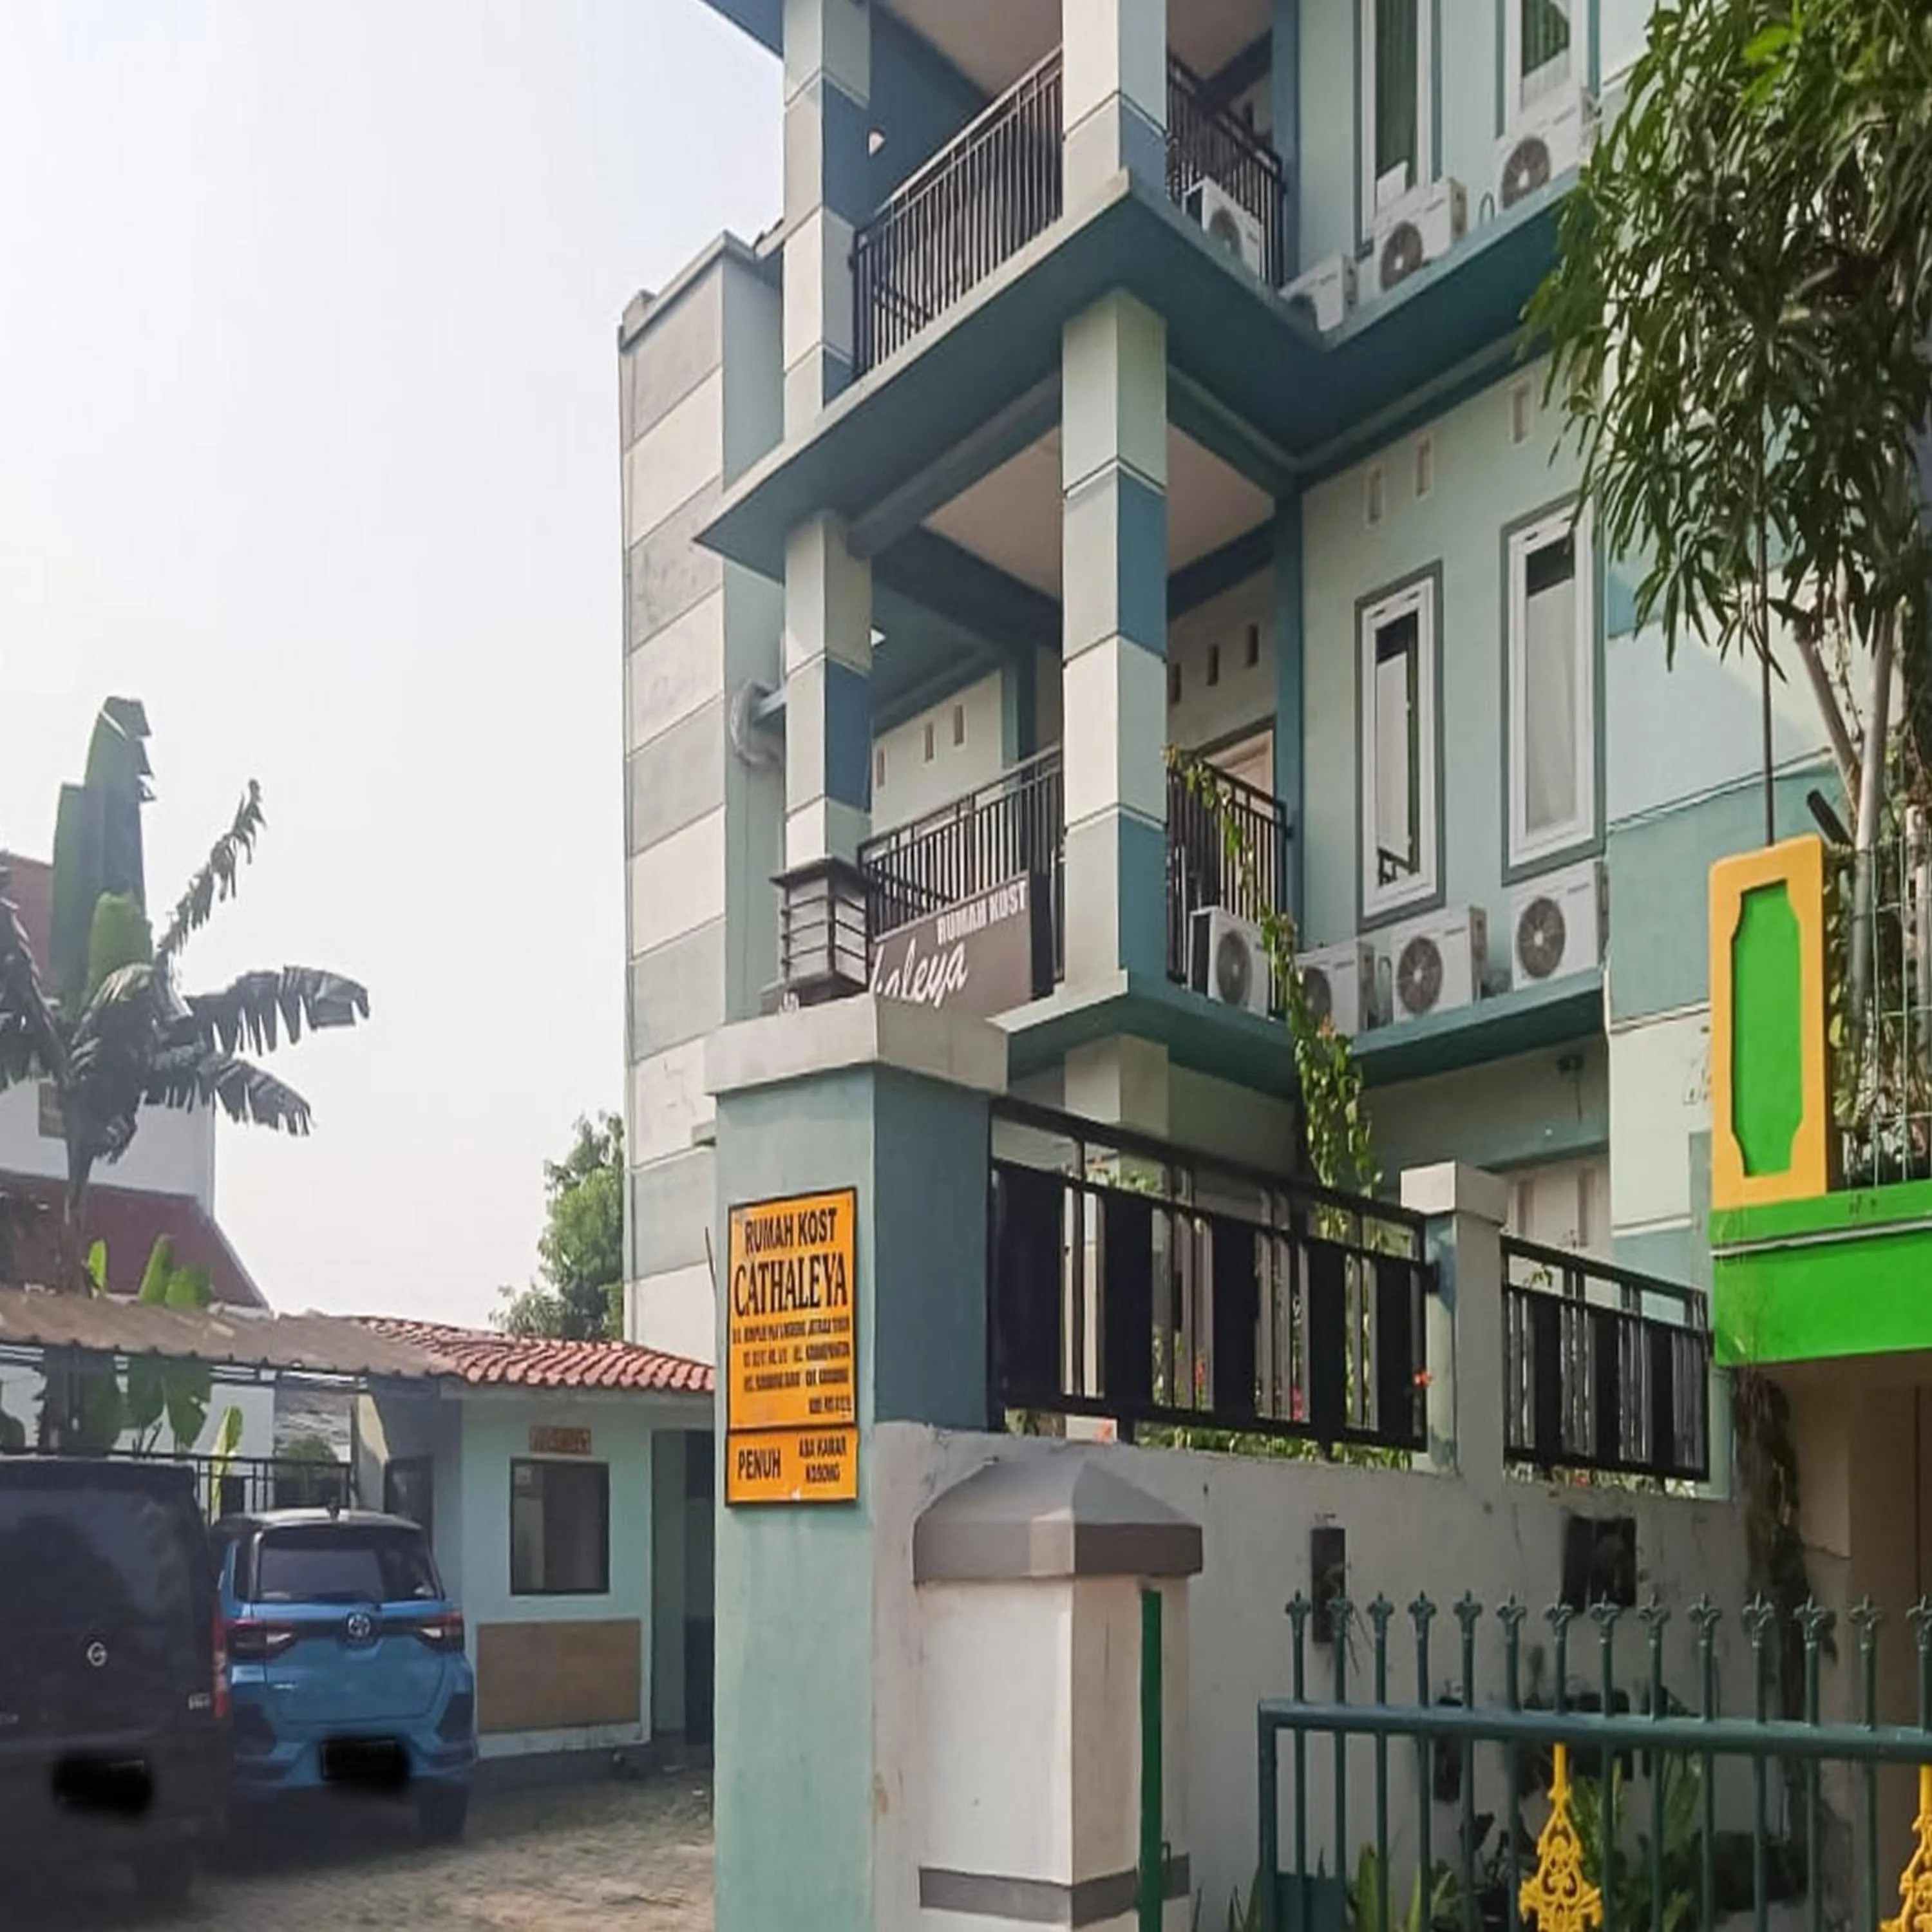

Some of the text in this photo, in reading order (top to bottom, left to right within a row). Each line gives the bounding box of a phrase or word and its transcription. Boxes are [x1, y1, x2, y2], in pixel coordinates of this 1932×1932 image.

[937, 880, 1027, 946] RUMAH KOST
[745, 1208, 837, 1255] RUMAH KOST
[734, 1252, 848, 1318] CATHALEYA
[738, 1448, 781, 1481] PENUH
